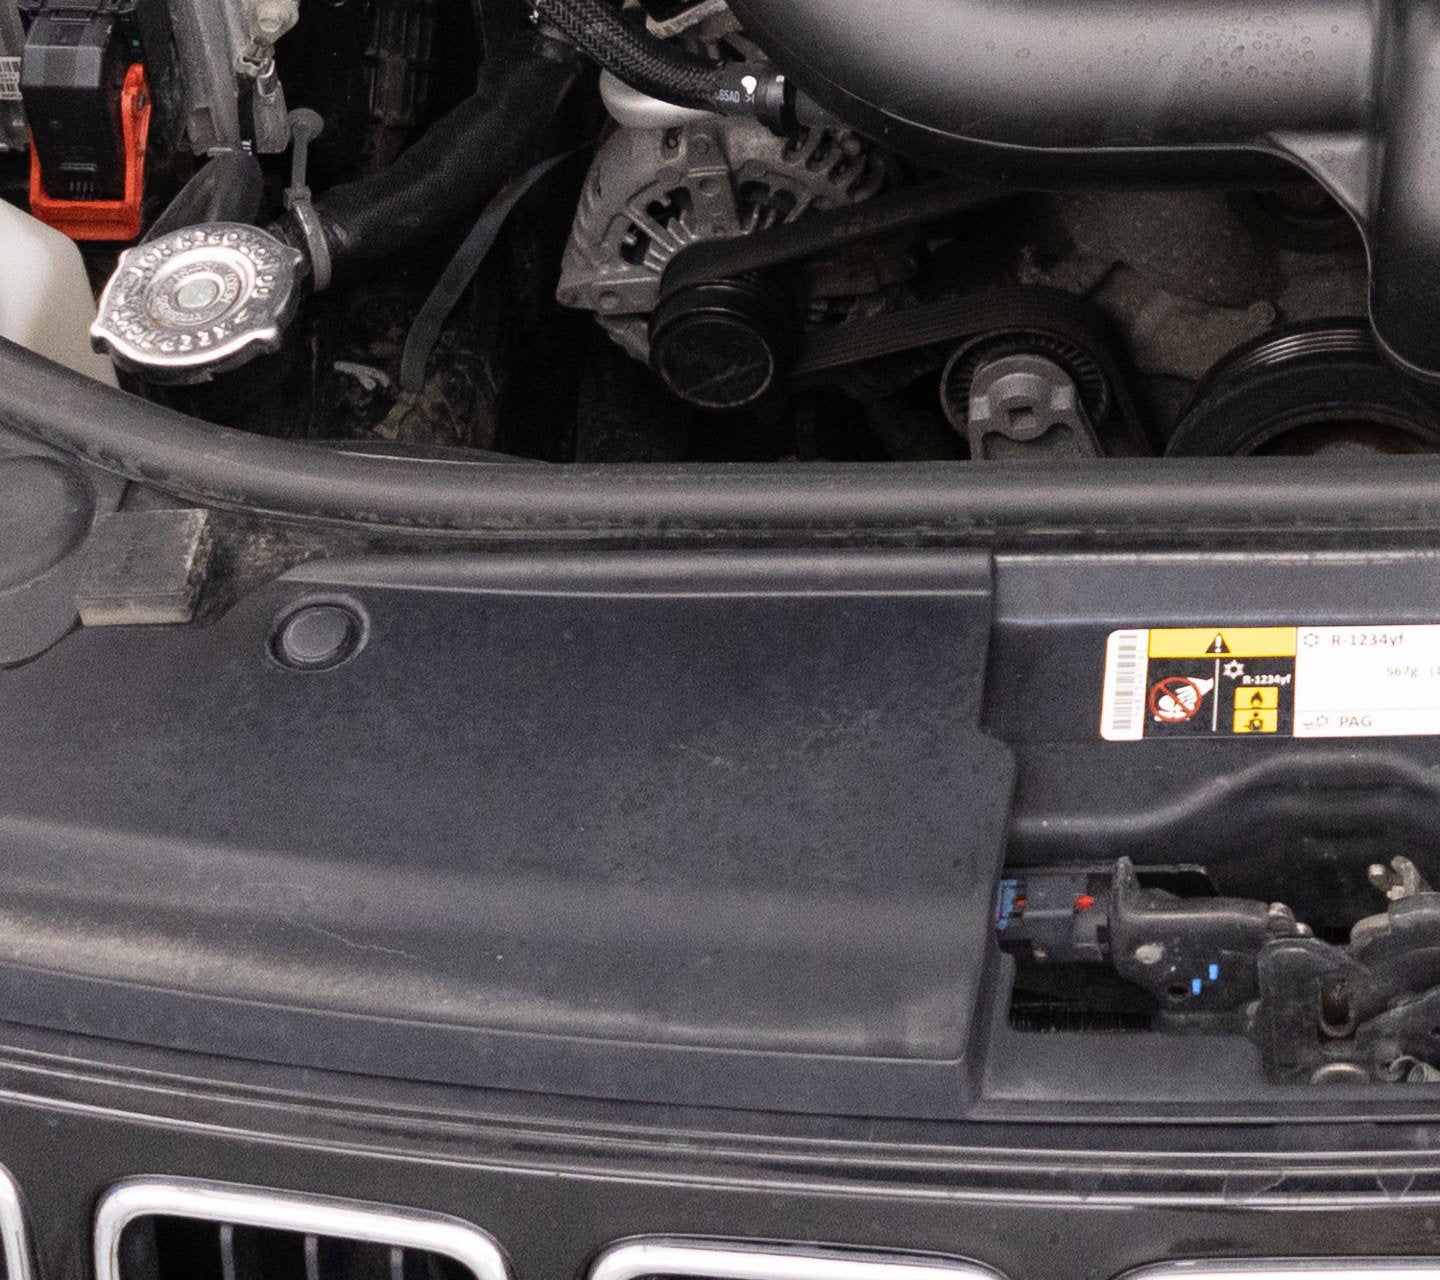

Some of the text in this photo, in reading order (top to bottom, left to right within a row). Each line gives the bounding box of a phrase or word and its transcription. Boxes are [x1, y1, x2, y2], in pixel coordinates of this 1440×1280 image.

[1331, 632, 1405, 649] R-1234yf
[1242, 673, 1292, 686] R-1234yf
[1339, 716, 1373, 729] PAG
